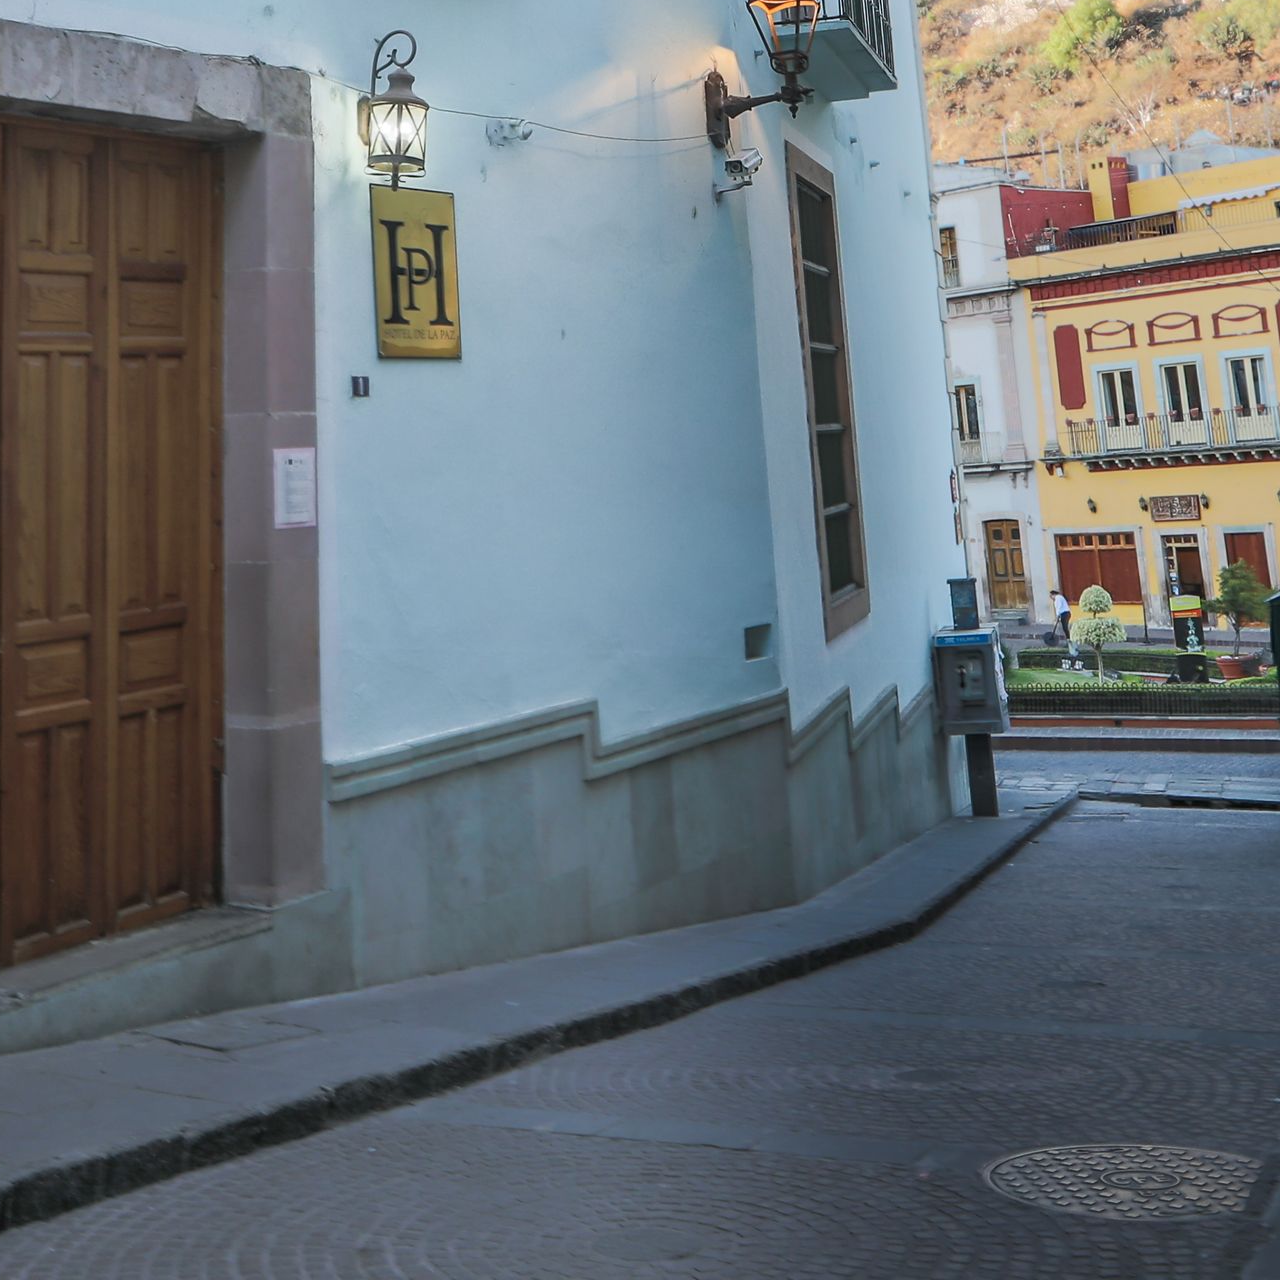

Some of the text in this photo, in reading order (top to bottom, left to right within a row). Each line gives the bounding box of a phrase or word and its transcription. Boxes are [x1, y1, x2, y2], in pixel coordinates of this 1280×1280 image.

[384, 329, 456, 340] HOTEL DE LA PAZ
[1110, 1174, 1169, 1185] CFE
